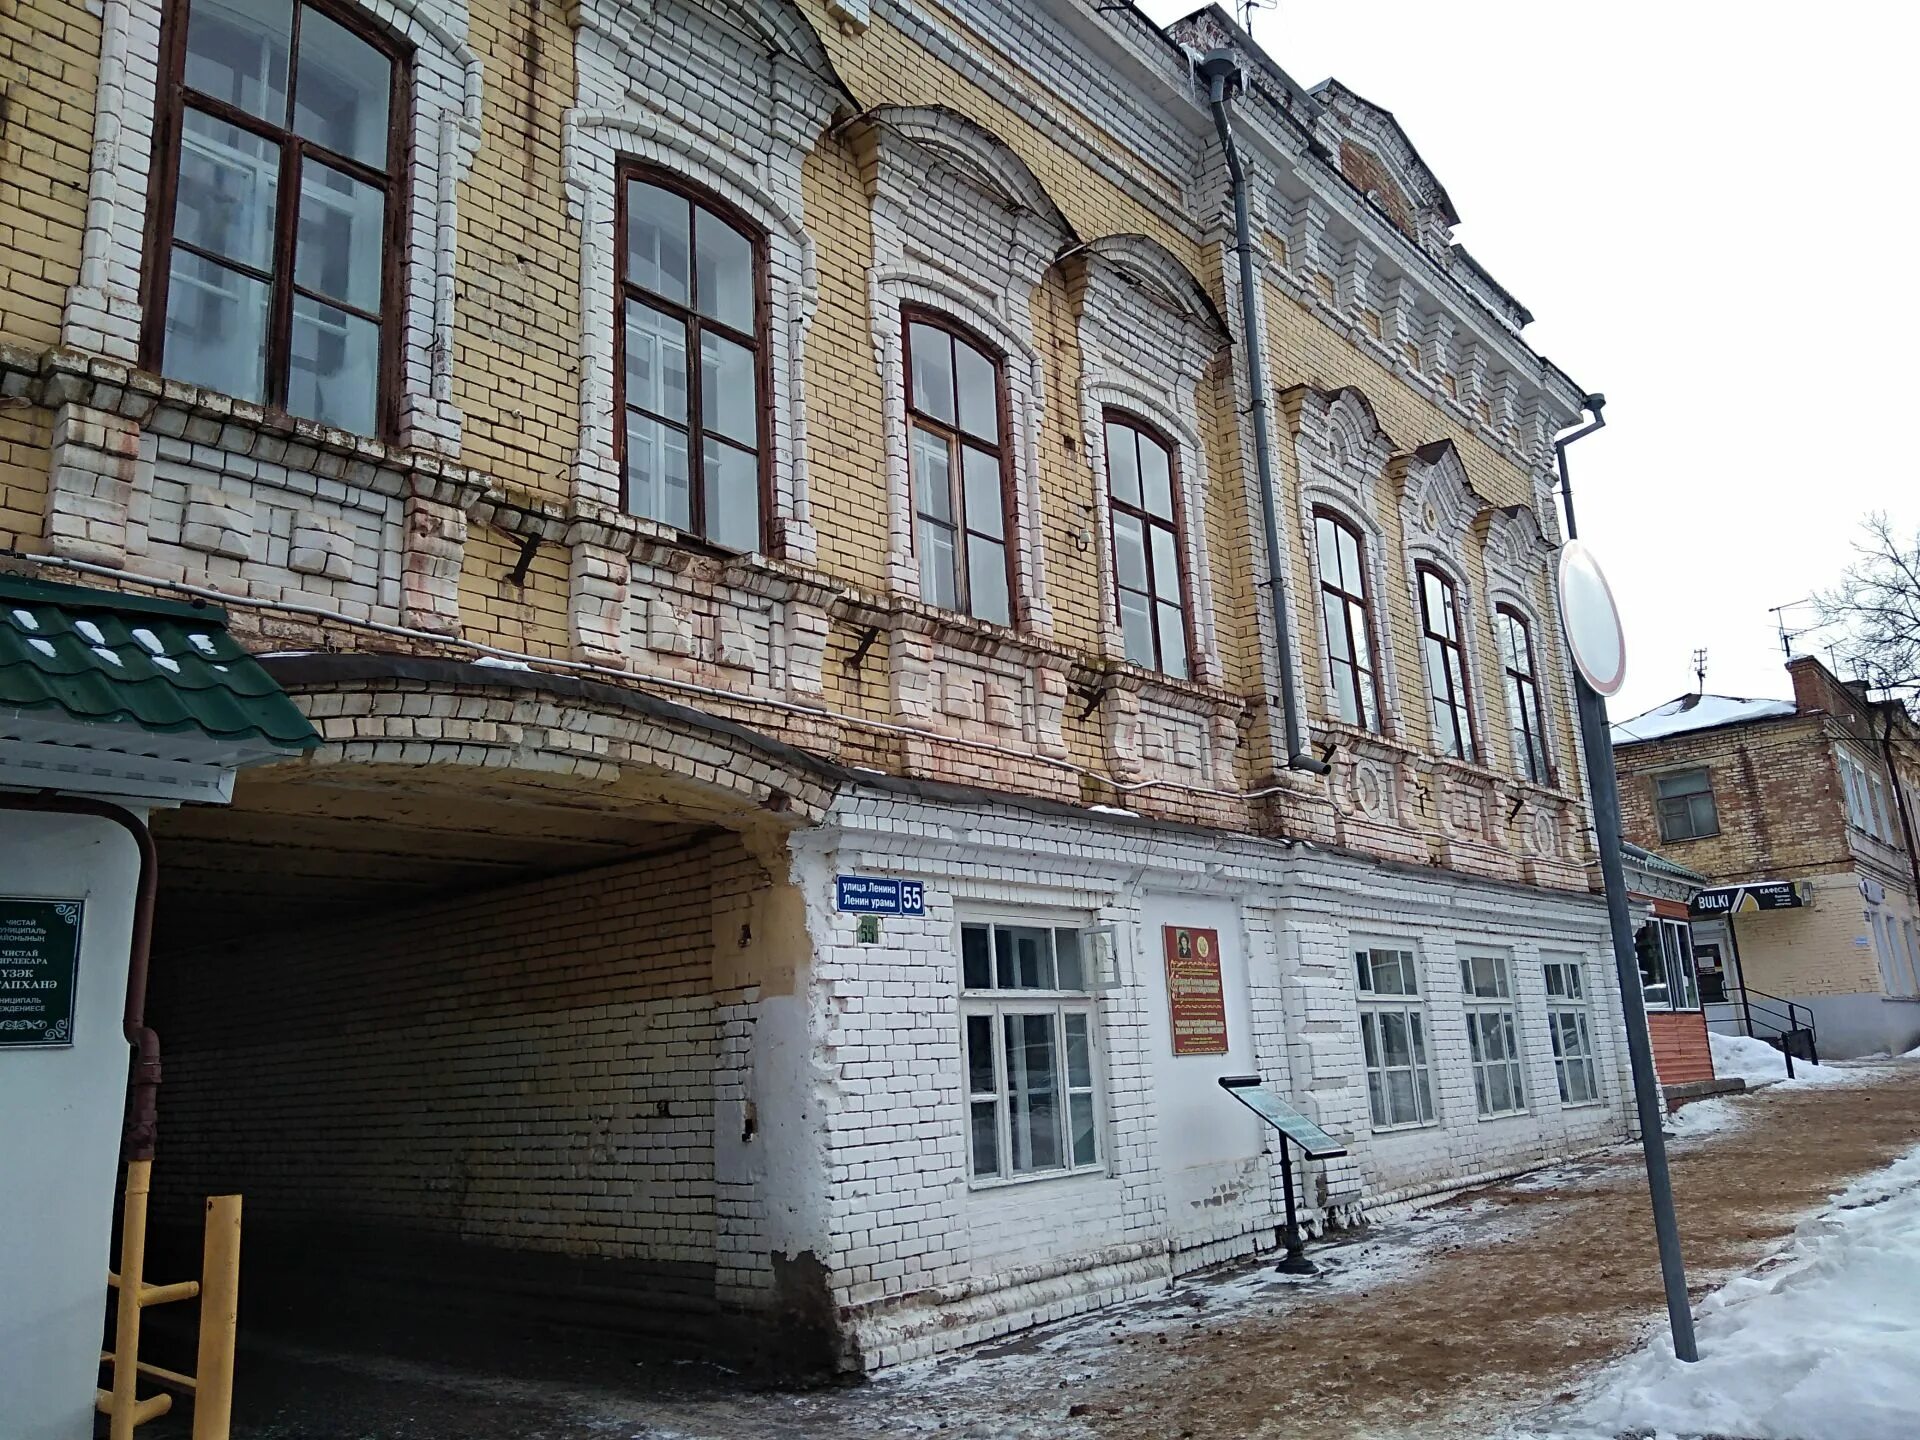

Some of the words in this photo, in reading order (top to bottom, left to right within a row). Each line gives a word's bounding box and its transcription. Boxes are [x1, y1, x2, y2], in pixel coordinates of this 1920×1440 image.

[842, 882, 866, 893] улица
[868, 882, 896, 894] Ленина
[844, 894, 869, 906] Ленин
[870, 898, 896, 909] урамы
[903, 886, 921, 909] 55
[1699, 895, 1729, 909] BULKI
[2, 949, 39, 957] ЧИСТАЙ
[0, 980, 58, 989] АПХАНӘ
